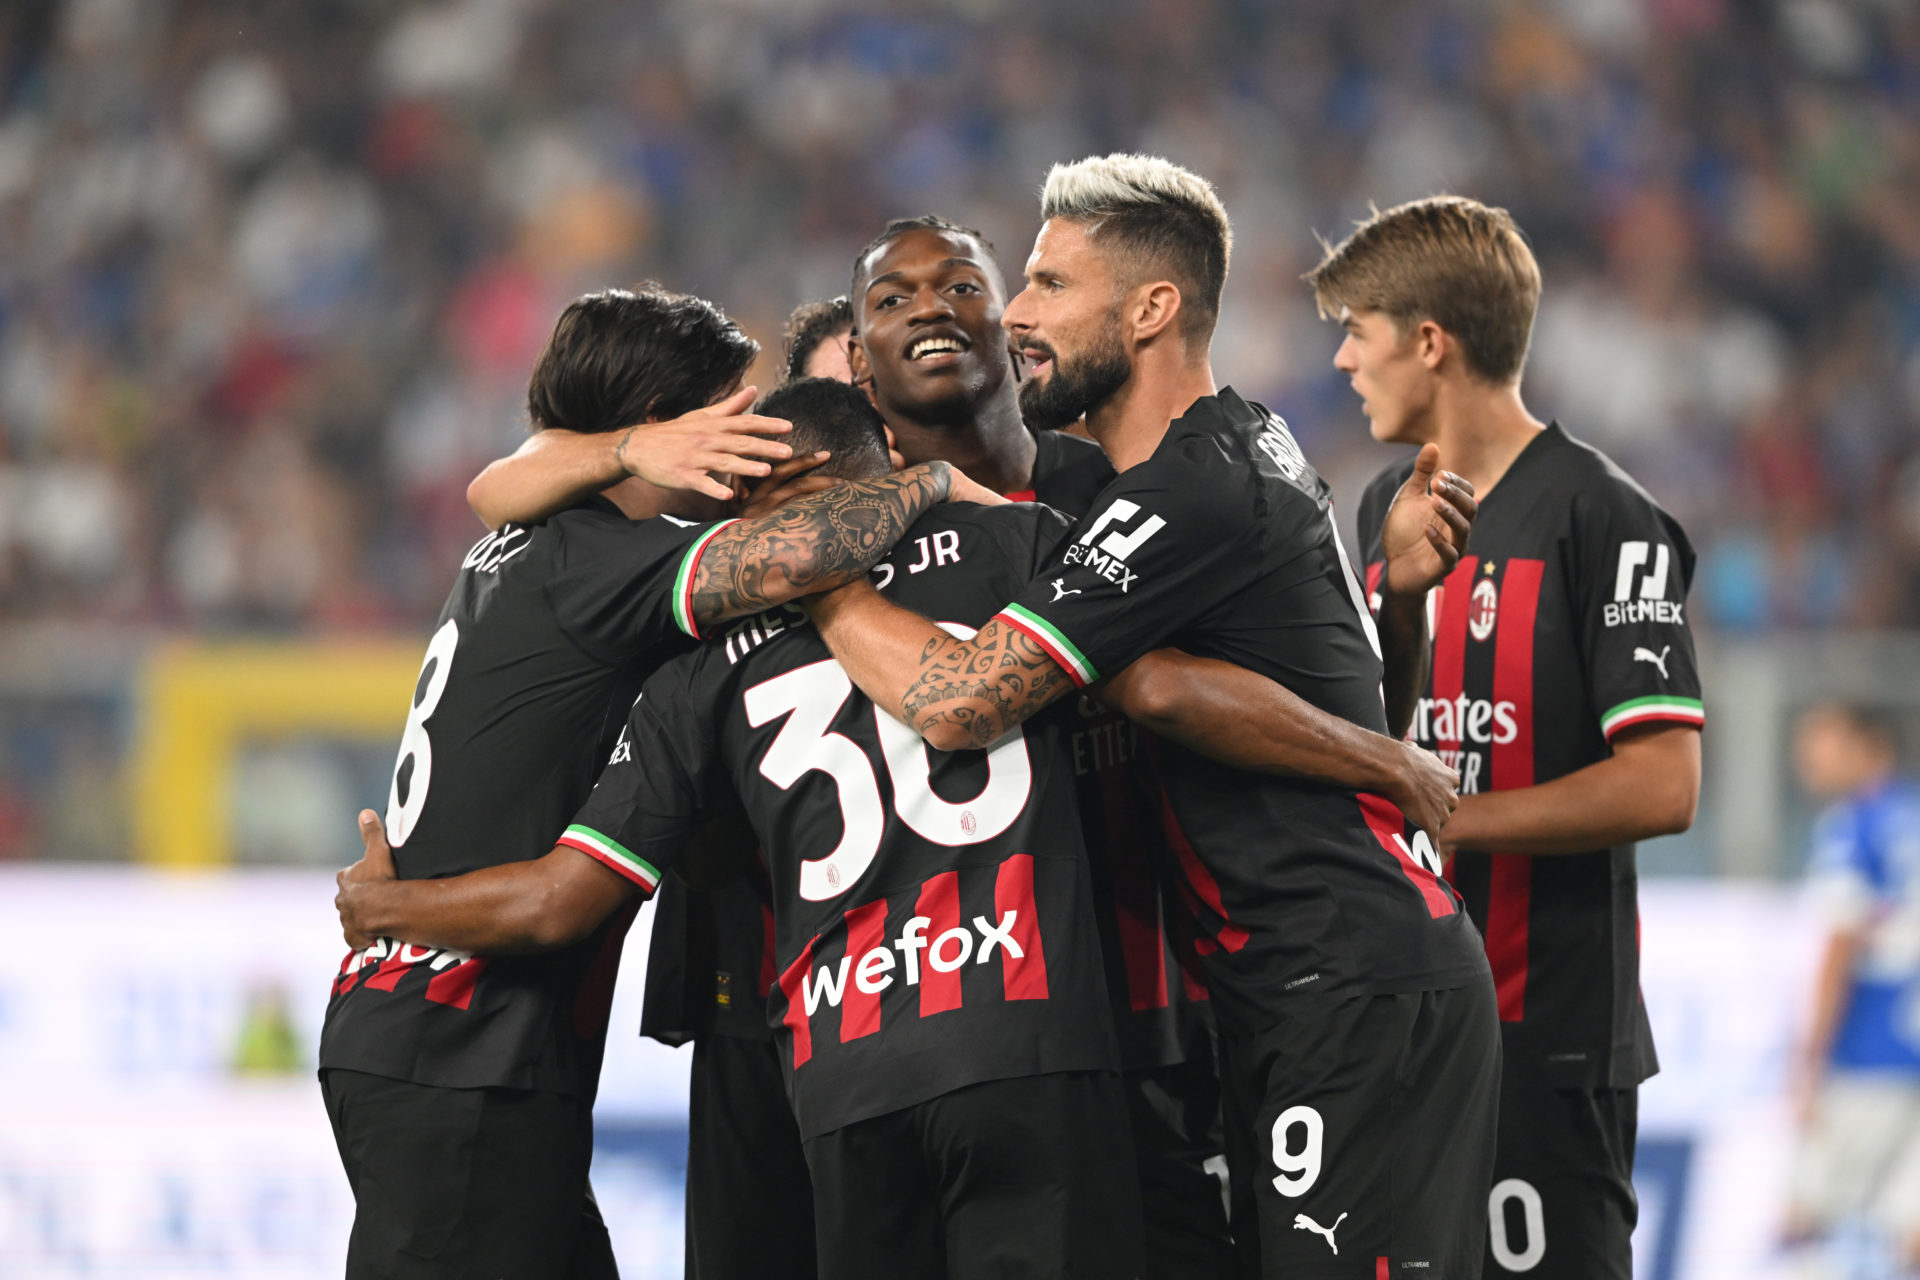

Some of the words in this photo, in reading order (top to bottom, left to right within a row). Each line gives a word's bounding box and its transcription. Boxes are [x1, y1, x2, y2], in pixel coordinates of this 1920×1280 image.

[908, 530, 962, 574] JR
[1063, 544, 1139, 594] BiMEX
[1603, 599, 1684, 627] BitMEX
[385, 618, 459, 848] 8
[743, 621, 1032, 901] 30
[802, 908, 1025, 1017] wefox
[1272, 1105, 1324, 1197] 9
